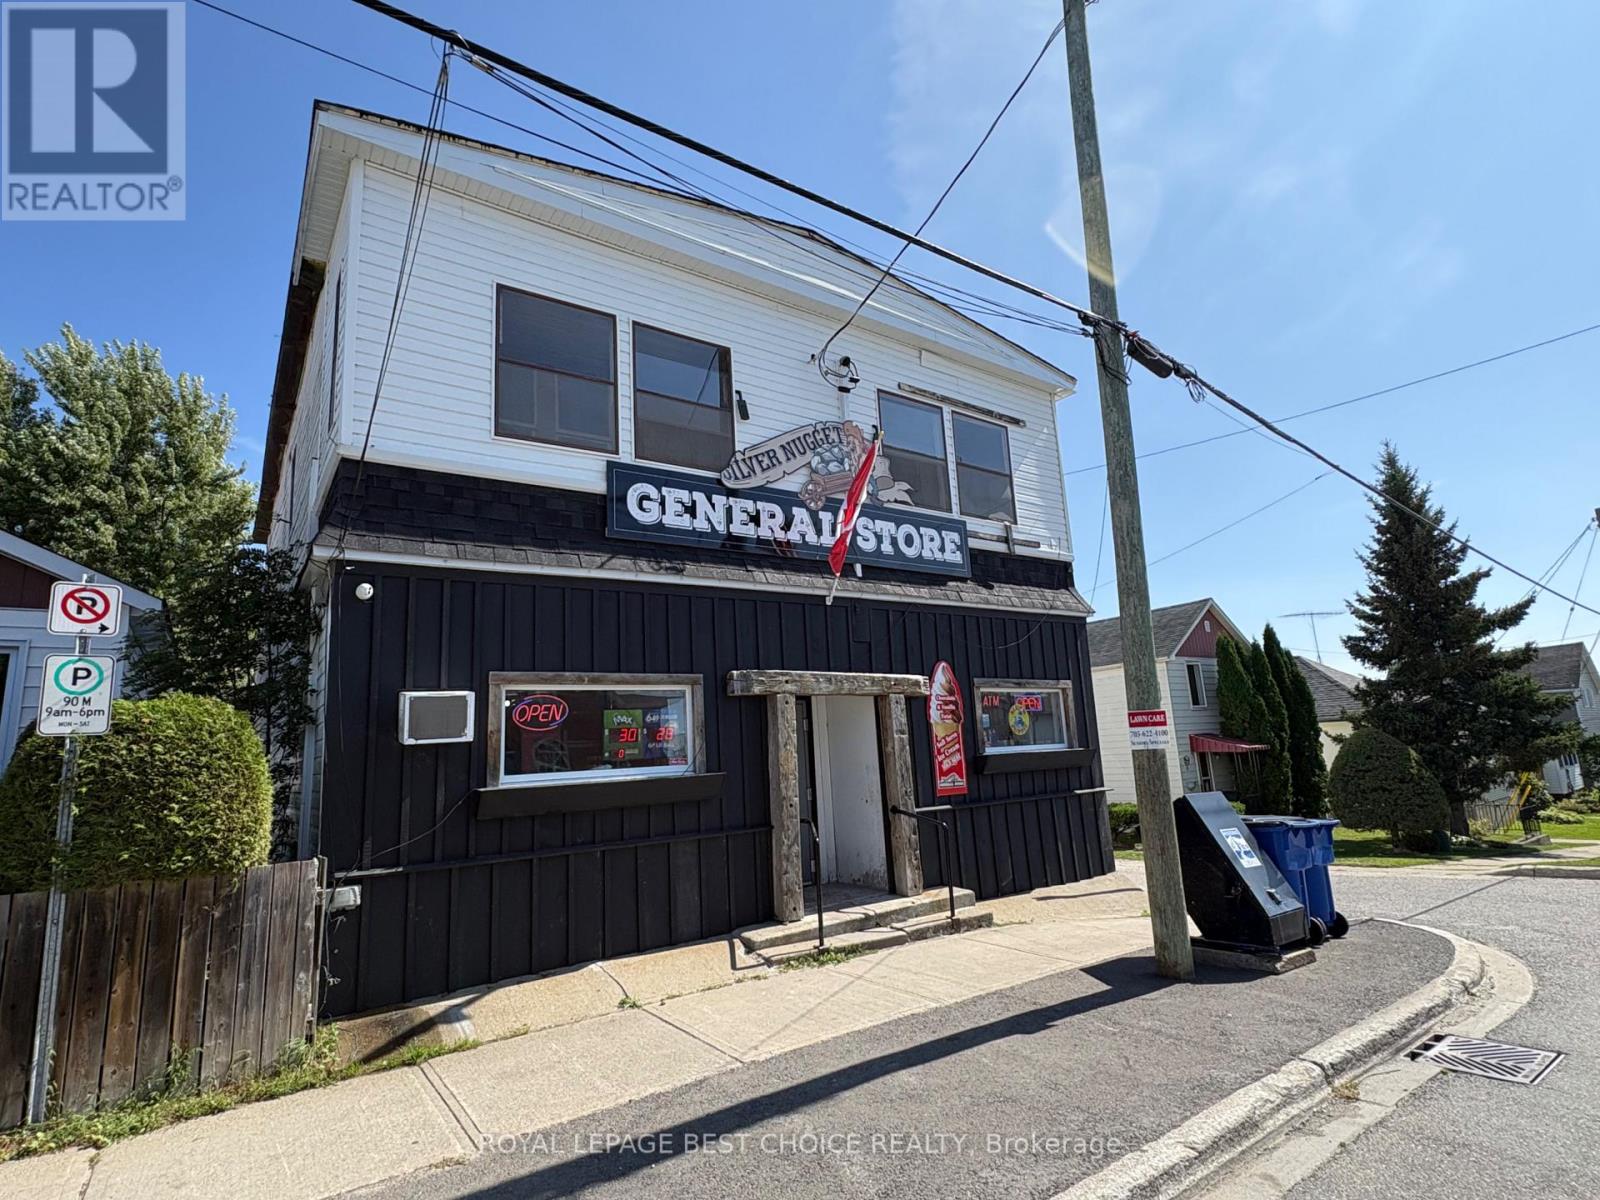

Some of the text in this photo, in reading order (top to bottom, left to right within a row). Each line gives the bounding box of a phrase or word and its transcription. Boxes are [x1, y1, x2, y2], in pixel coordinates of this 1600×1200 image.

[780, 426, 844, 461] NUGGET
[626, 482, 963, 564] GENERAL STORE
[72, 667, 92, 686] P
[63, 696, 92, 707] 90 M
[983, 695, 999, 706] ATM
[45, 706, 105, 719] 9am-6pm
[515, 704, 563, 722] OPEN
[1130, 714, 1165, 723] LAWN CARE
[619, 728, 638, 742] 30
